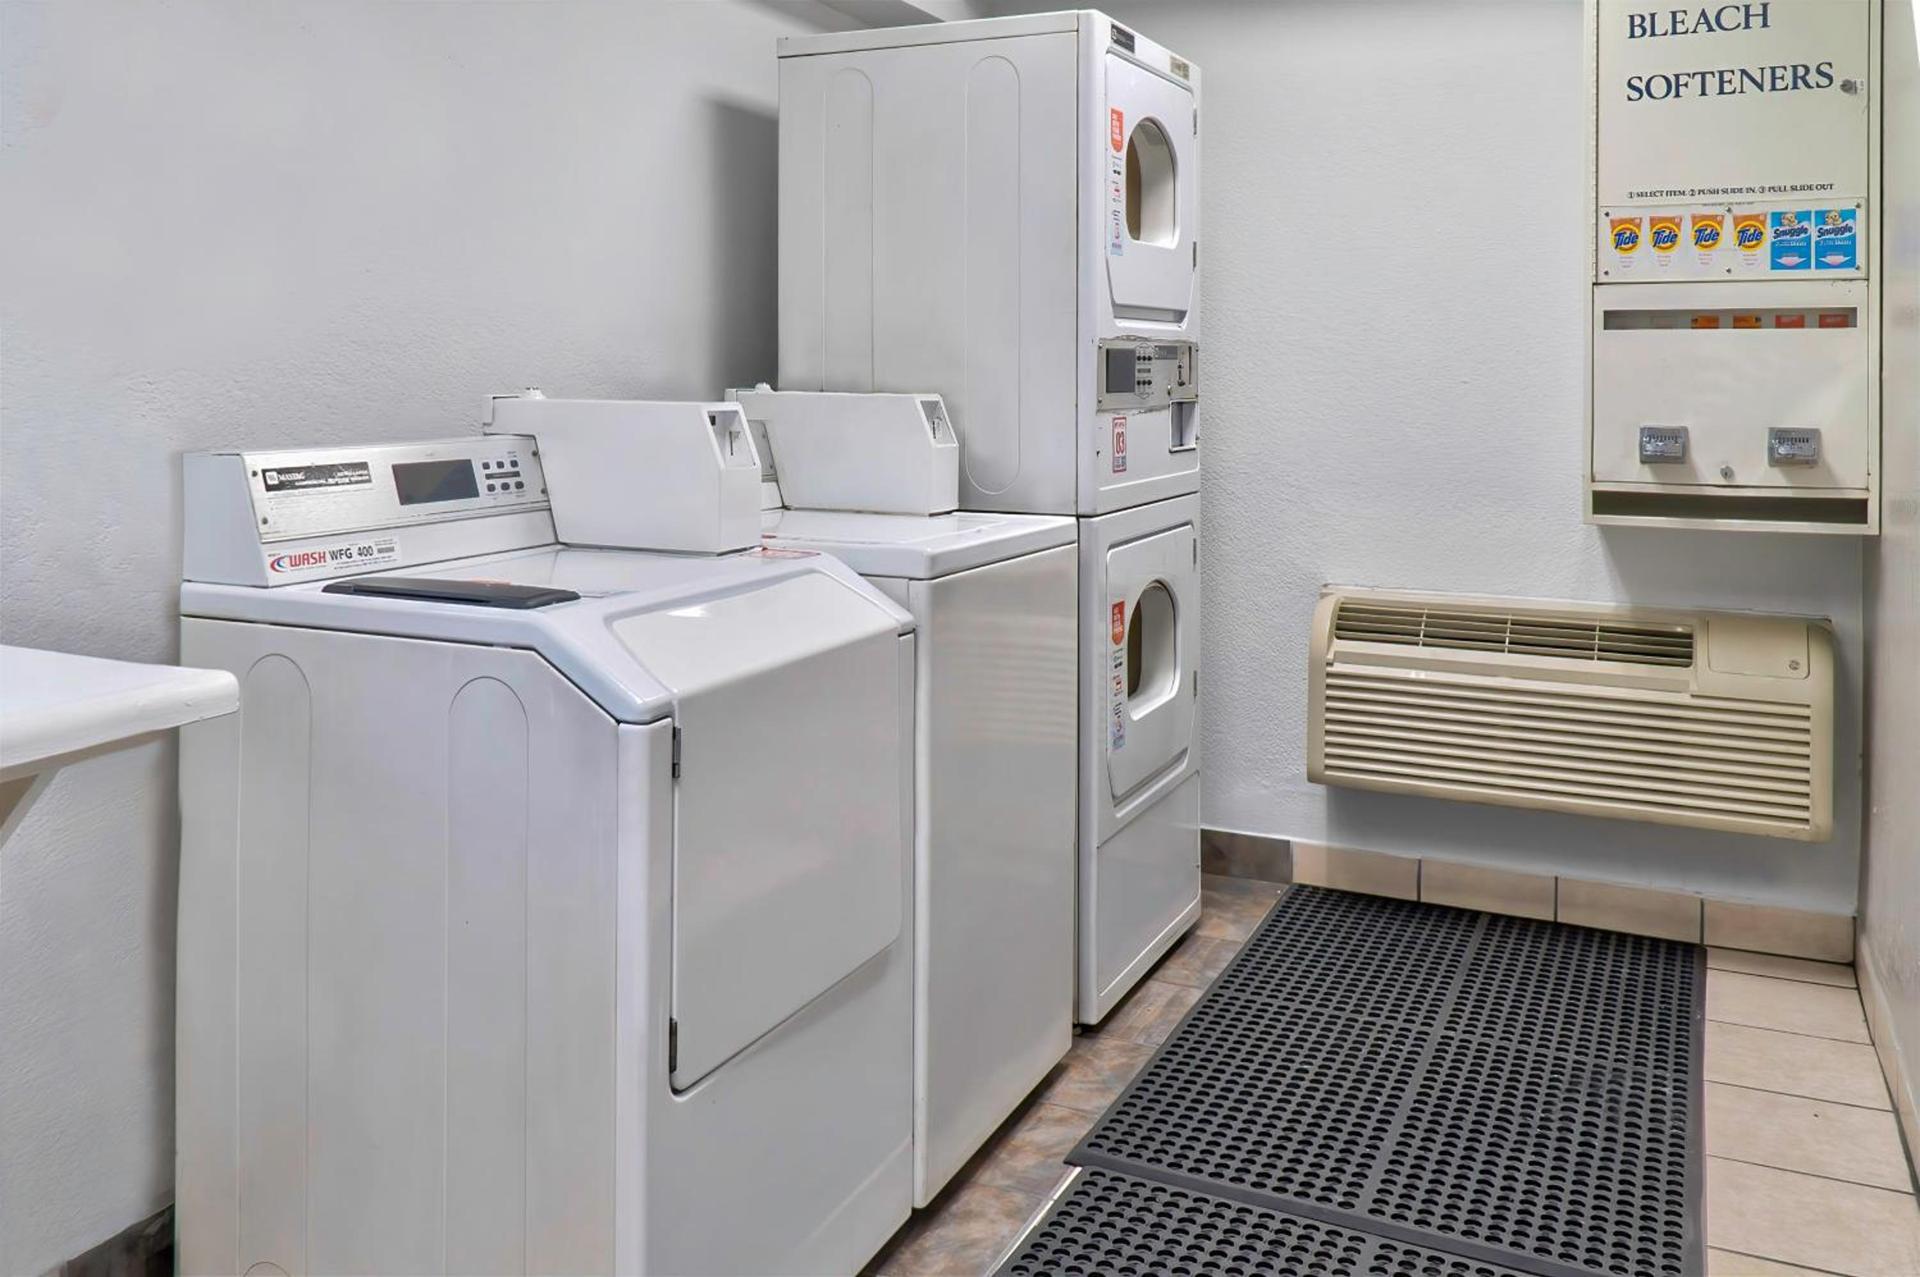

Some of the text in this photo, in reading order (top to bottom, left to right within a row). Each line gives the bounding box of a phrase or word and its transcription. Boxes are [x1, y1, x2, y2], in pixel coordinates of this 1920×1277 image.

[1627, 2, 1771, 39] BLEACH
[1626, 61, 1834, 102] SOFTENERS
[1636, 190, 1664, 198] SELECT
[1697, 188, 1720, 196] PUSH
[1721, 187, 1743, 195] SLIDE
[1768, 185, 1787, 193] PULL
[1790, 184, 1814, 192] SLIDE
[1815, 183, 1834, 191] OUT
[1614, 231, 1639, 249] Tide
[1652, 229, 1678, 248] Tide
[1694, 227, 1719, 246] Tide
[1737, 227, 1763, 247] Tide
[1773, 225, 1809, 240] Snuggle
[1817, 223, 1853, 238] Snuggle
[288, 550, 327, 568] WASH
[328, 547, 353, 561] WFG
[357, 544, 374, 557] 400
